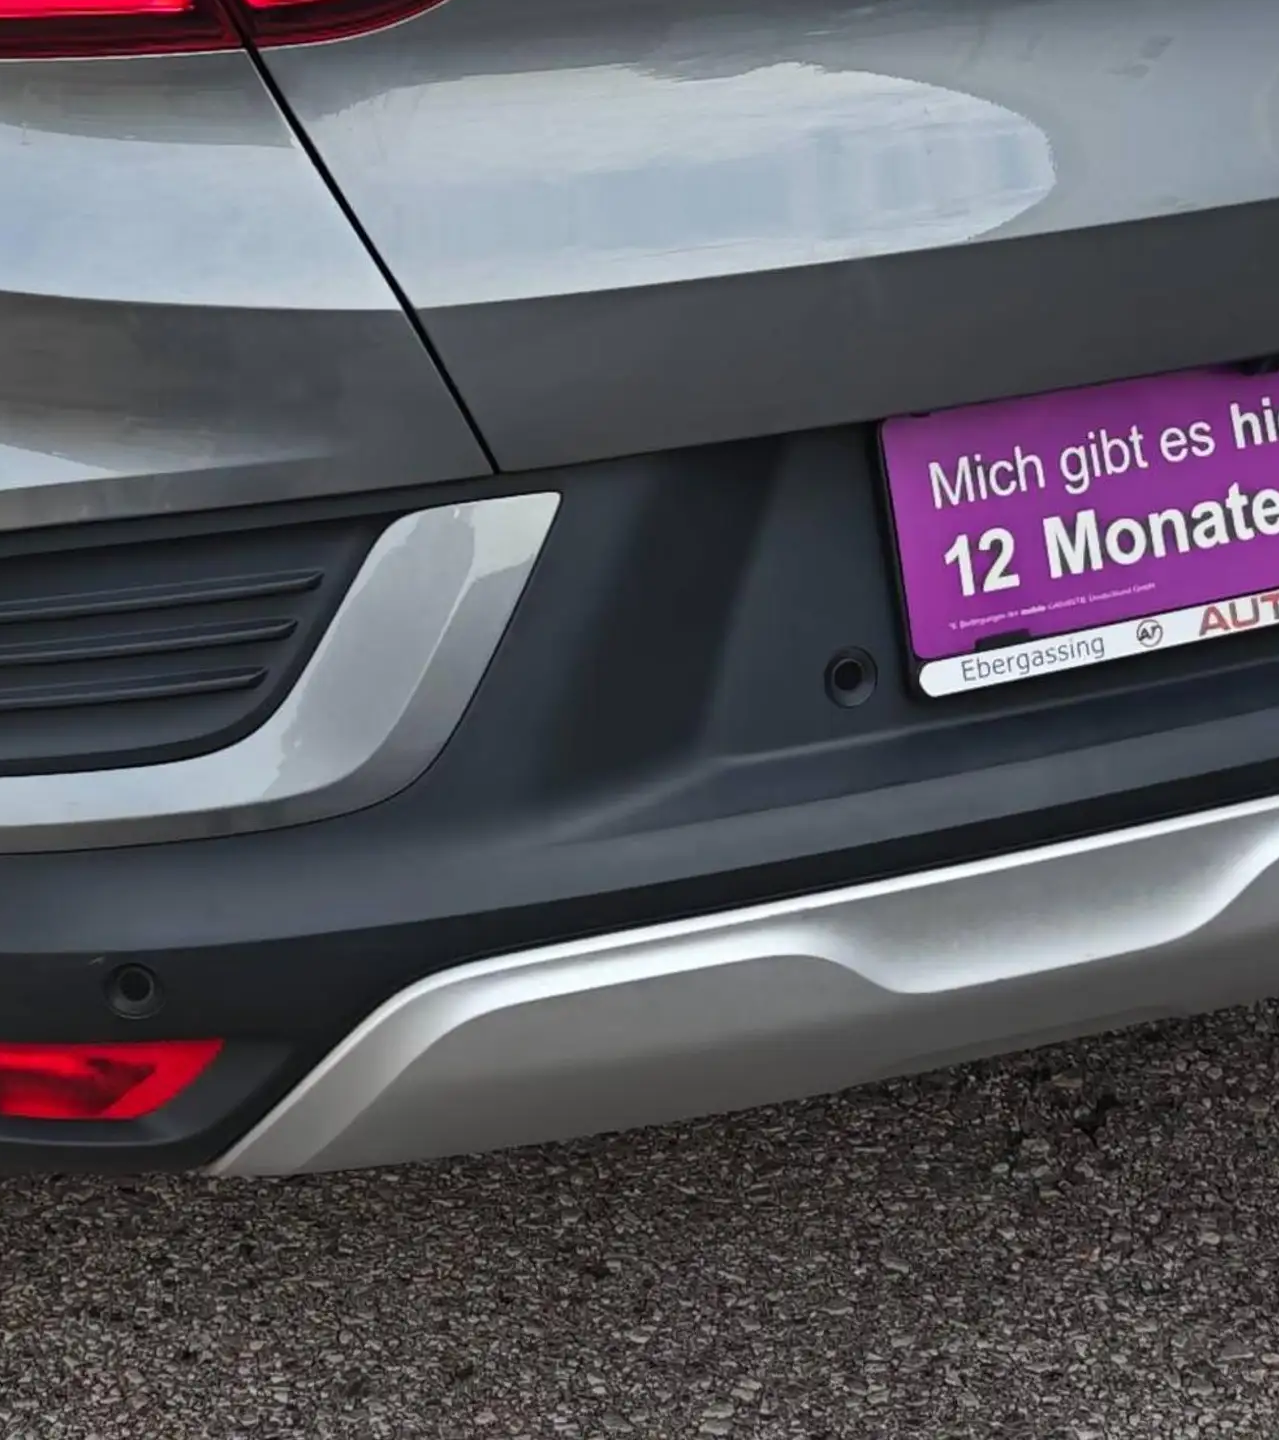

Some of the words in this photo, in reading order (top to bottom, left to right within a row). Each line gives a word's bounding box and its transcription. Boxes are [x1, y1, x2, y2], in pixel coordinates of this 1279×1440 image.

[928, 445, 1046, 510] Mich
[1059, 425, 1149, 495] gibt
[1159, 421, 1216, 463] es
[944, 526, 1021, 597] 12
[960, 635, 1106, 682] Ebergassing
